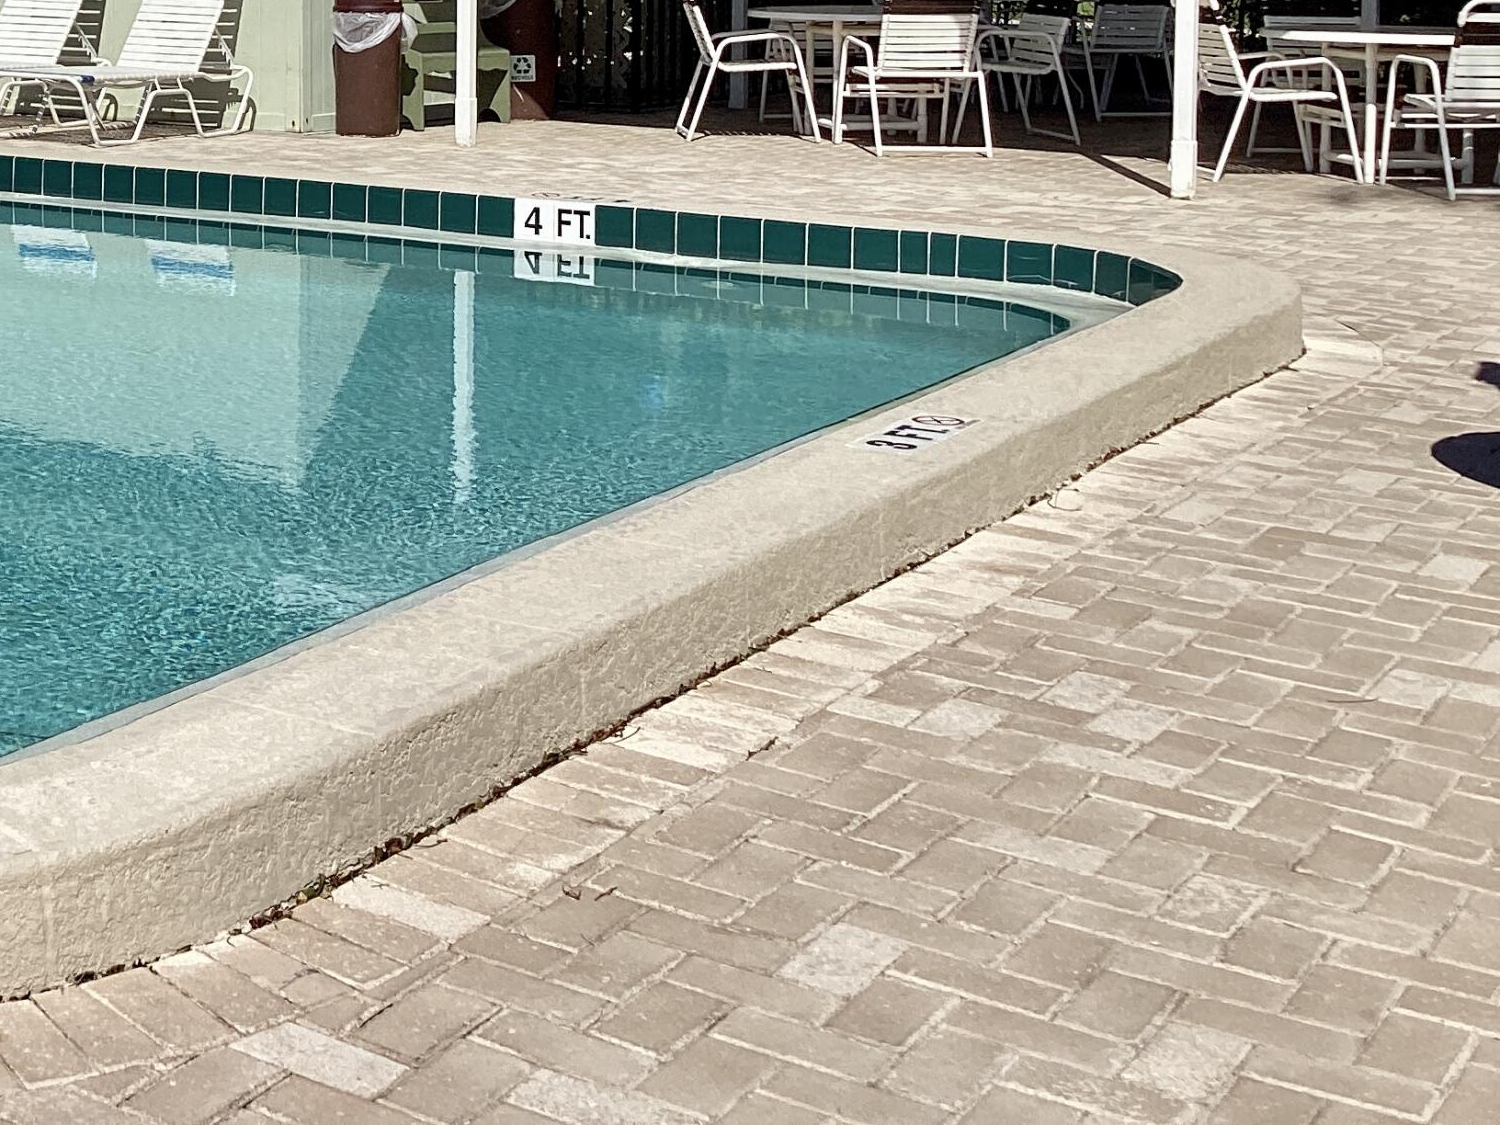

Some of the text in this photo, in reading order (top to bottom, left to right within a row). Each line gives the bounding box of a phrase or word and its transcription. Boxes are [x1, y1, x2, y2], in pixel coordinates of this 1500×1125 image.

[524, 206, 591, 240] 4 FT.
[865, 439, 918, 450] 3
